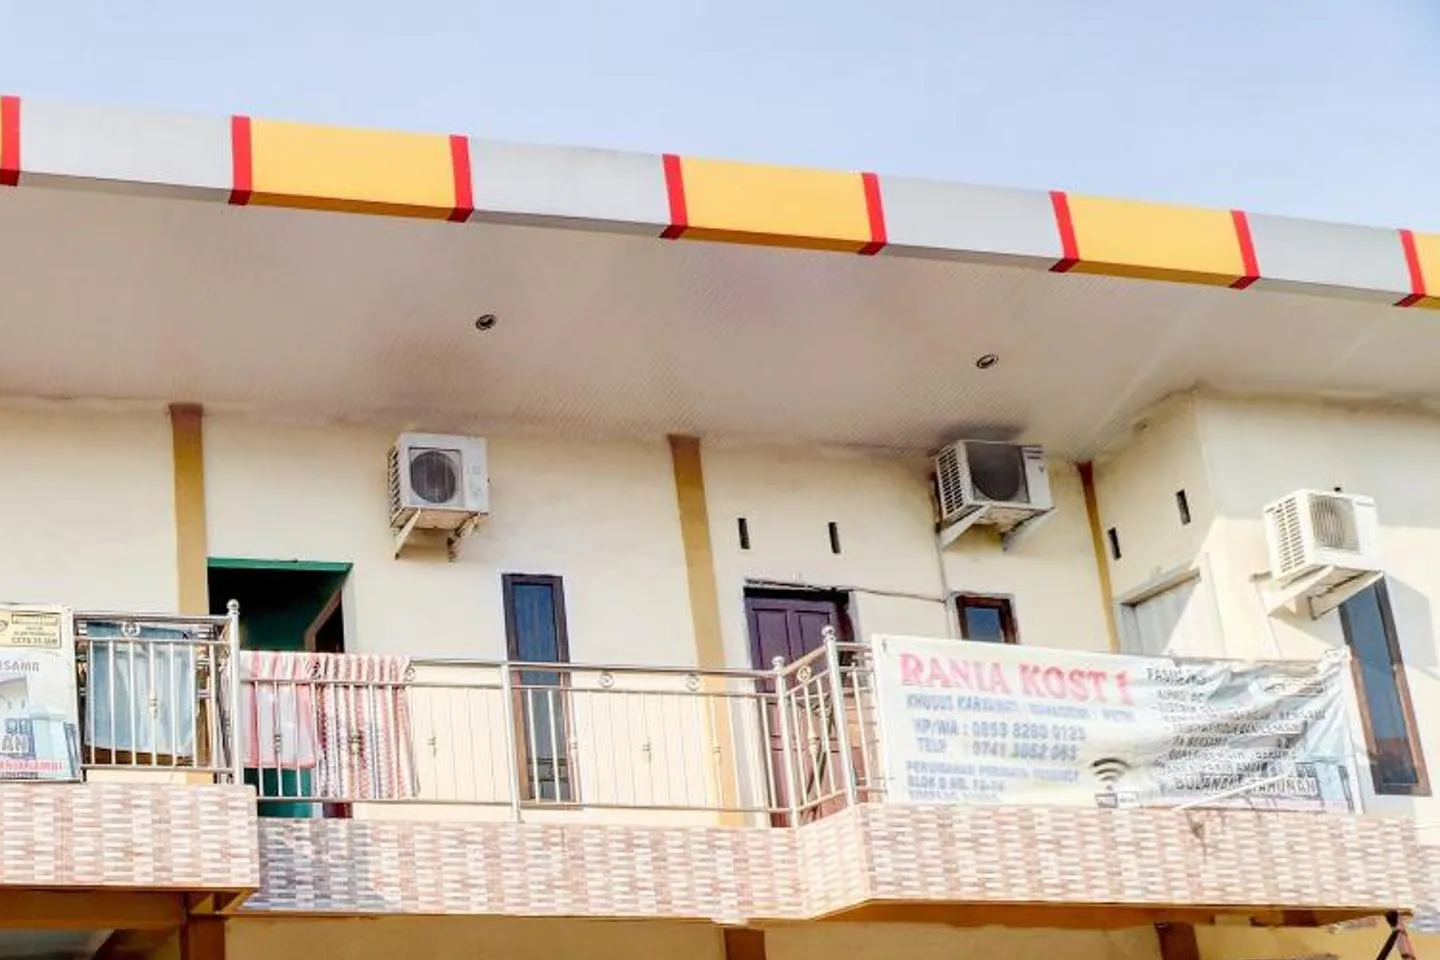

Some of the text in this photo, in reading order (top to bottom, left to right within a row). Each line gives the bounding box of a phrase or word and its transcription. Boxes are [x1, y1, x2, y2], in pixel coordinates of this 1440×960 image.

[900, 652, 1135, 706] RANIA KOST 1
